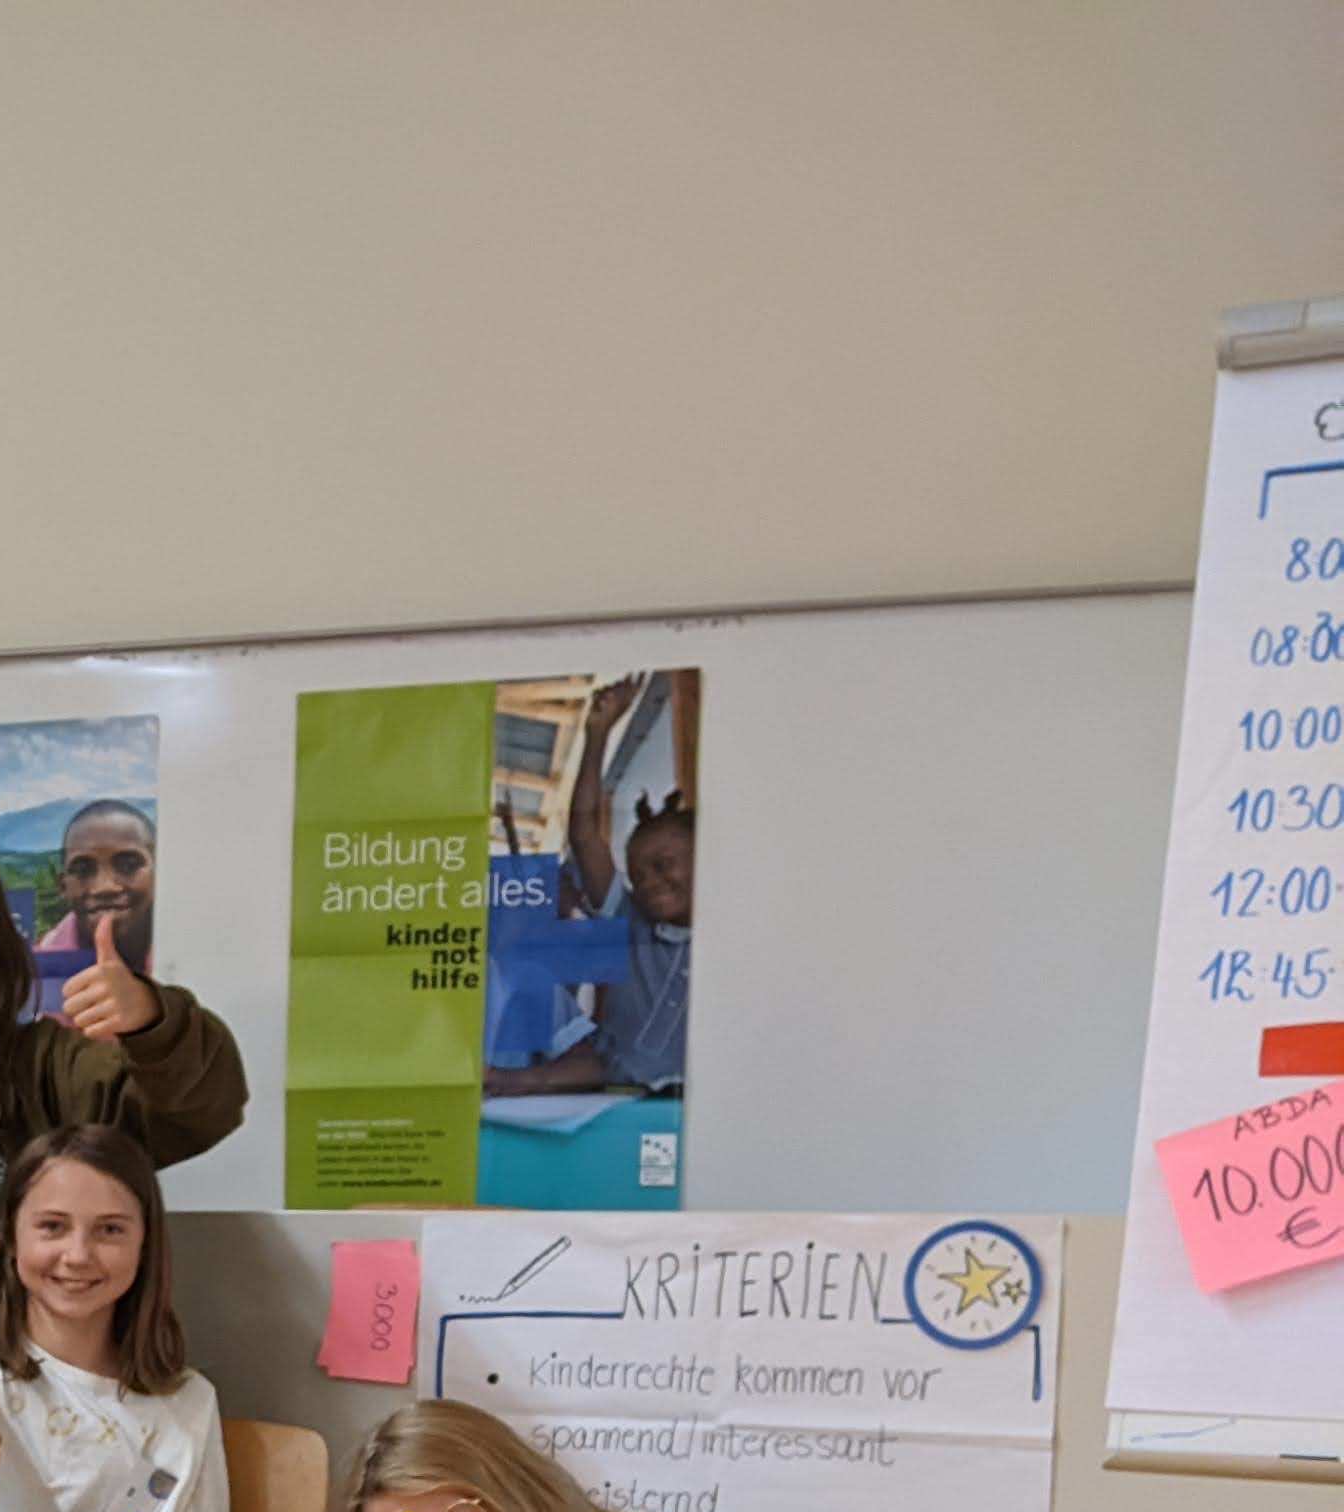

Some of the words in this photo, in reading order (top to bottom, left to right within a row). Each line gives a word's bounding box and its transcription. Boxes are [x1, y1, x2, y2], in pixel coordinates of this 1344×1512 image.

[323, 832, 466, 871] Bildung
[322, 875, 448, 912] ändert
[461, 872, 553, 908] alles.
[386, 923, 481, 947] kinder
[431, 947, 480, 965] not
[412, 968, 480, 990] hilfe
[1234, 1088, 1332, 1141] ABDA
[735, 1354, 863, 1396] kommen
[883, 1365, 943, 1401] vor
